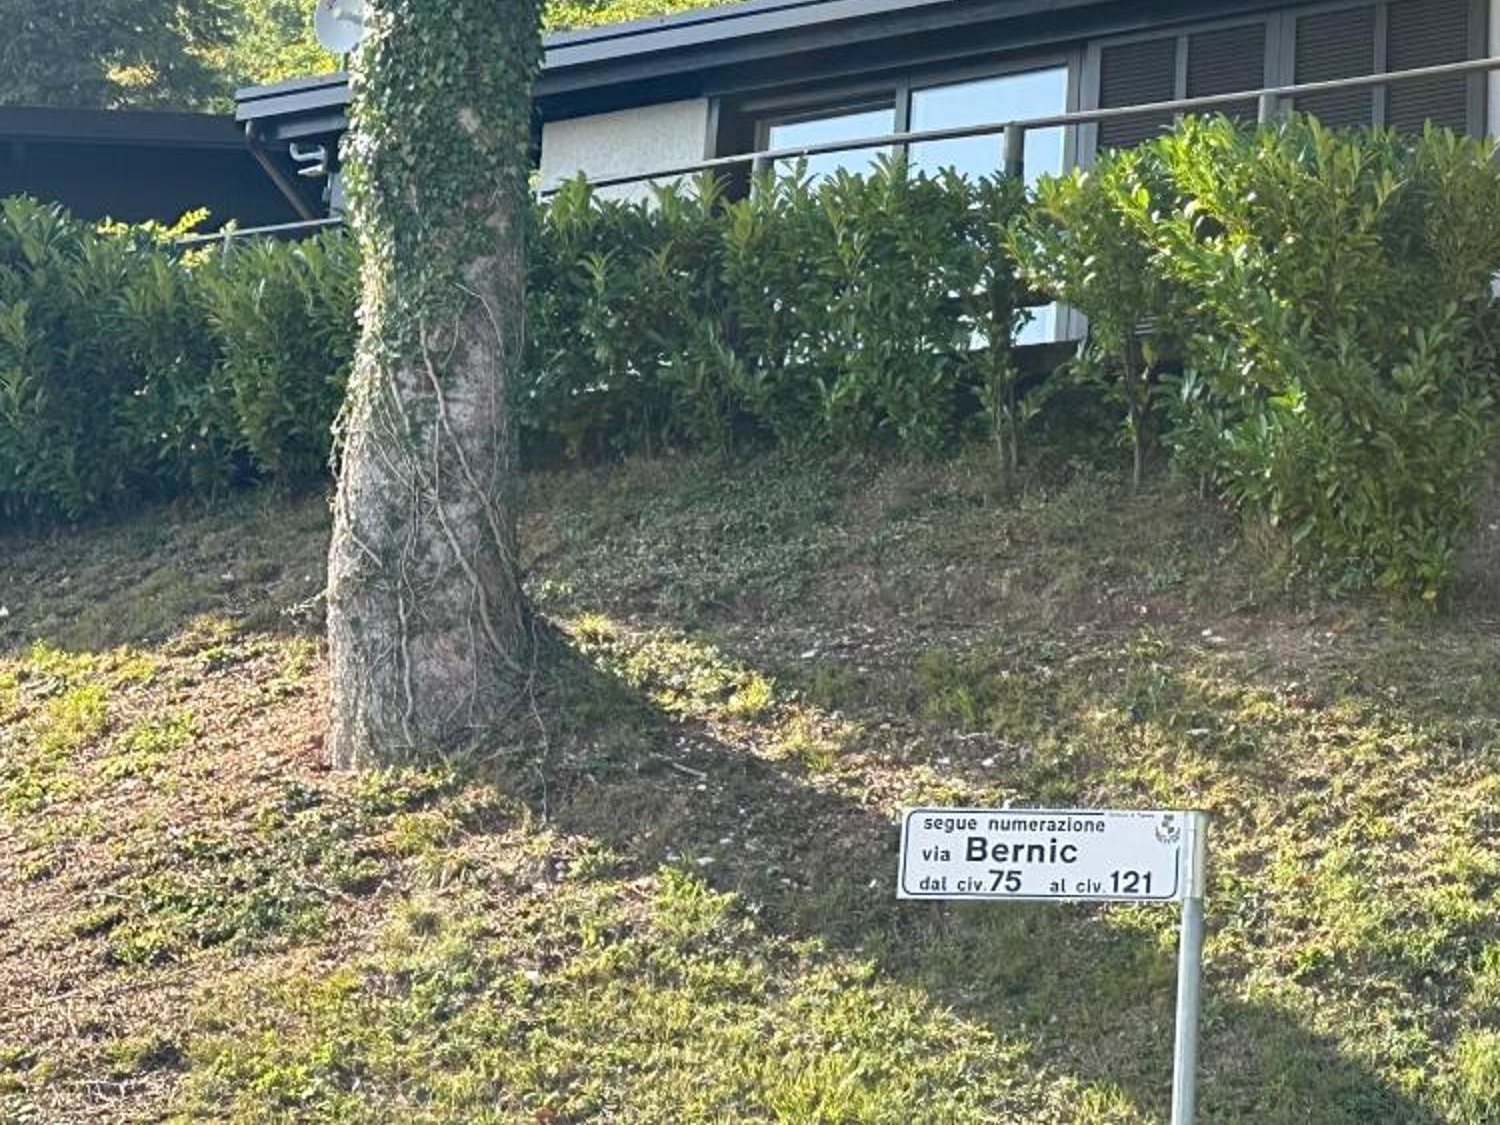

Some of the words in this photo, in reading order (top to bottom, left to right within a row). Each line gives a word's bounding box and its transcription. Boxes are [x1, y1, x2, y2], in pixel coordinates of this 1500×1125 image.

[924, 817, 977, 833] segue
[989, 817, 1105, 832] numerazione
[922, 846, 950, 861] via
[966, 837, 1077, 863] Bernic
[919, 877, 946, 891] dal
[1049, 879, 1065, 893] al
